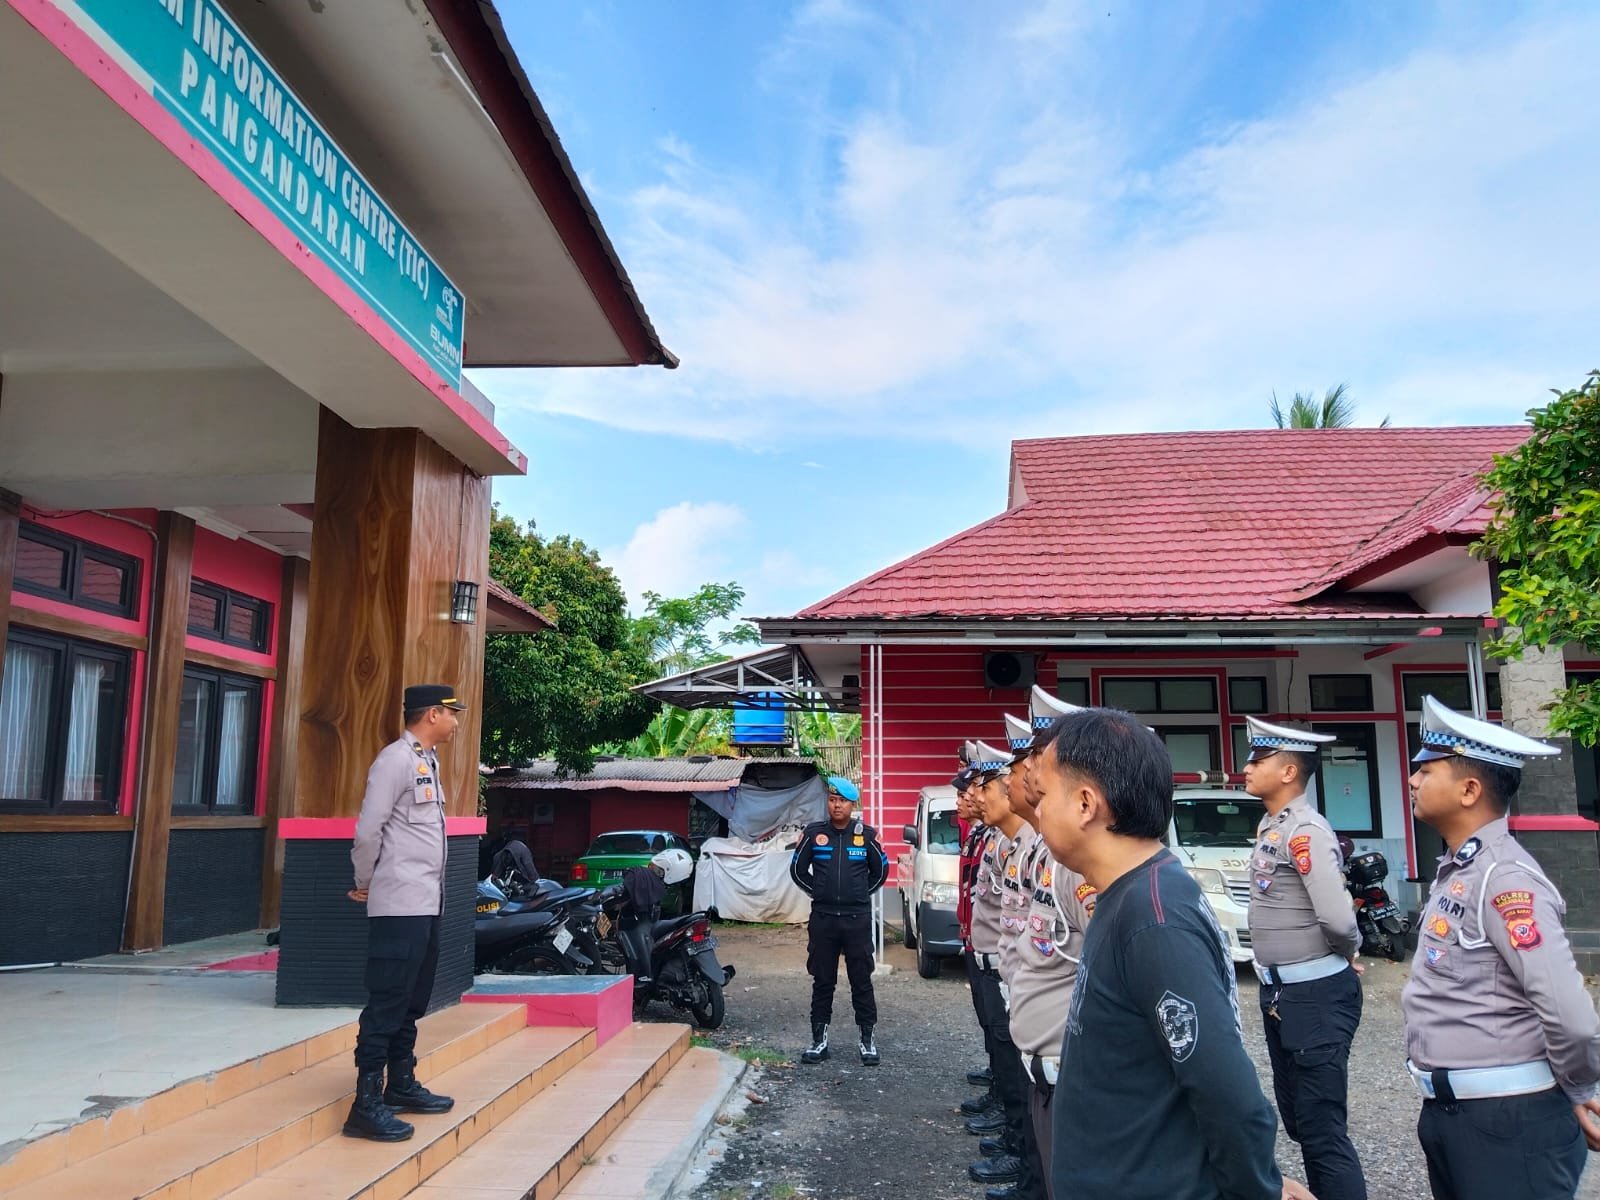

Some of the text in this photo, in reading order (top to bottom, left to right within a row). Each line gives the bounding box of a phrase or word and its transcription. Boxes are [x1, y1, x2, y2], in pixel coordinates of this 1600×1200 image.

[180, 49, 367, 276] PANGANDARAN
[192, 0, 429, 301] INFORMATION CENTRE (TIC)
[430, 323, 460, 365] BUMN
[476, 901, 501, 913] OLISI
